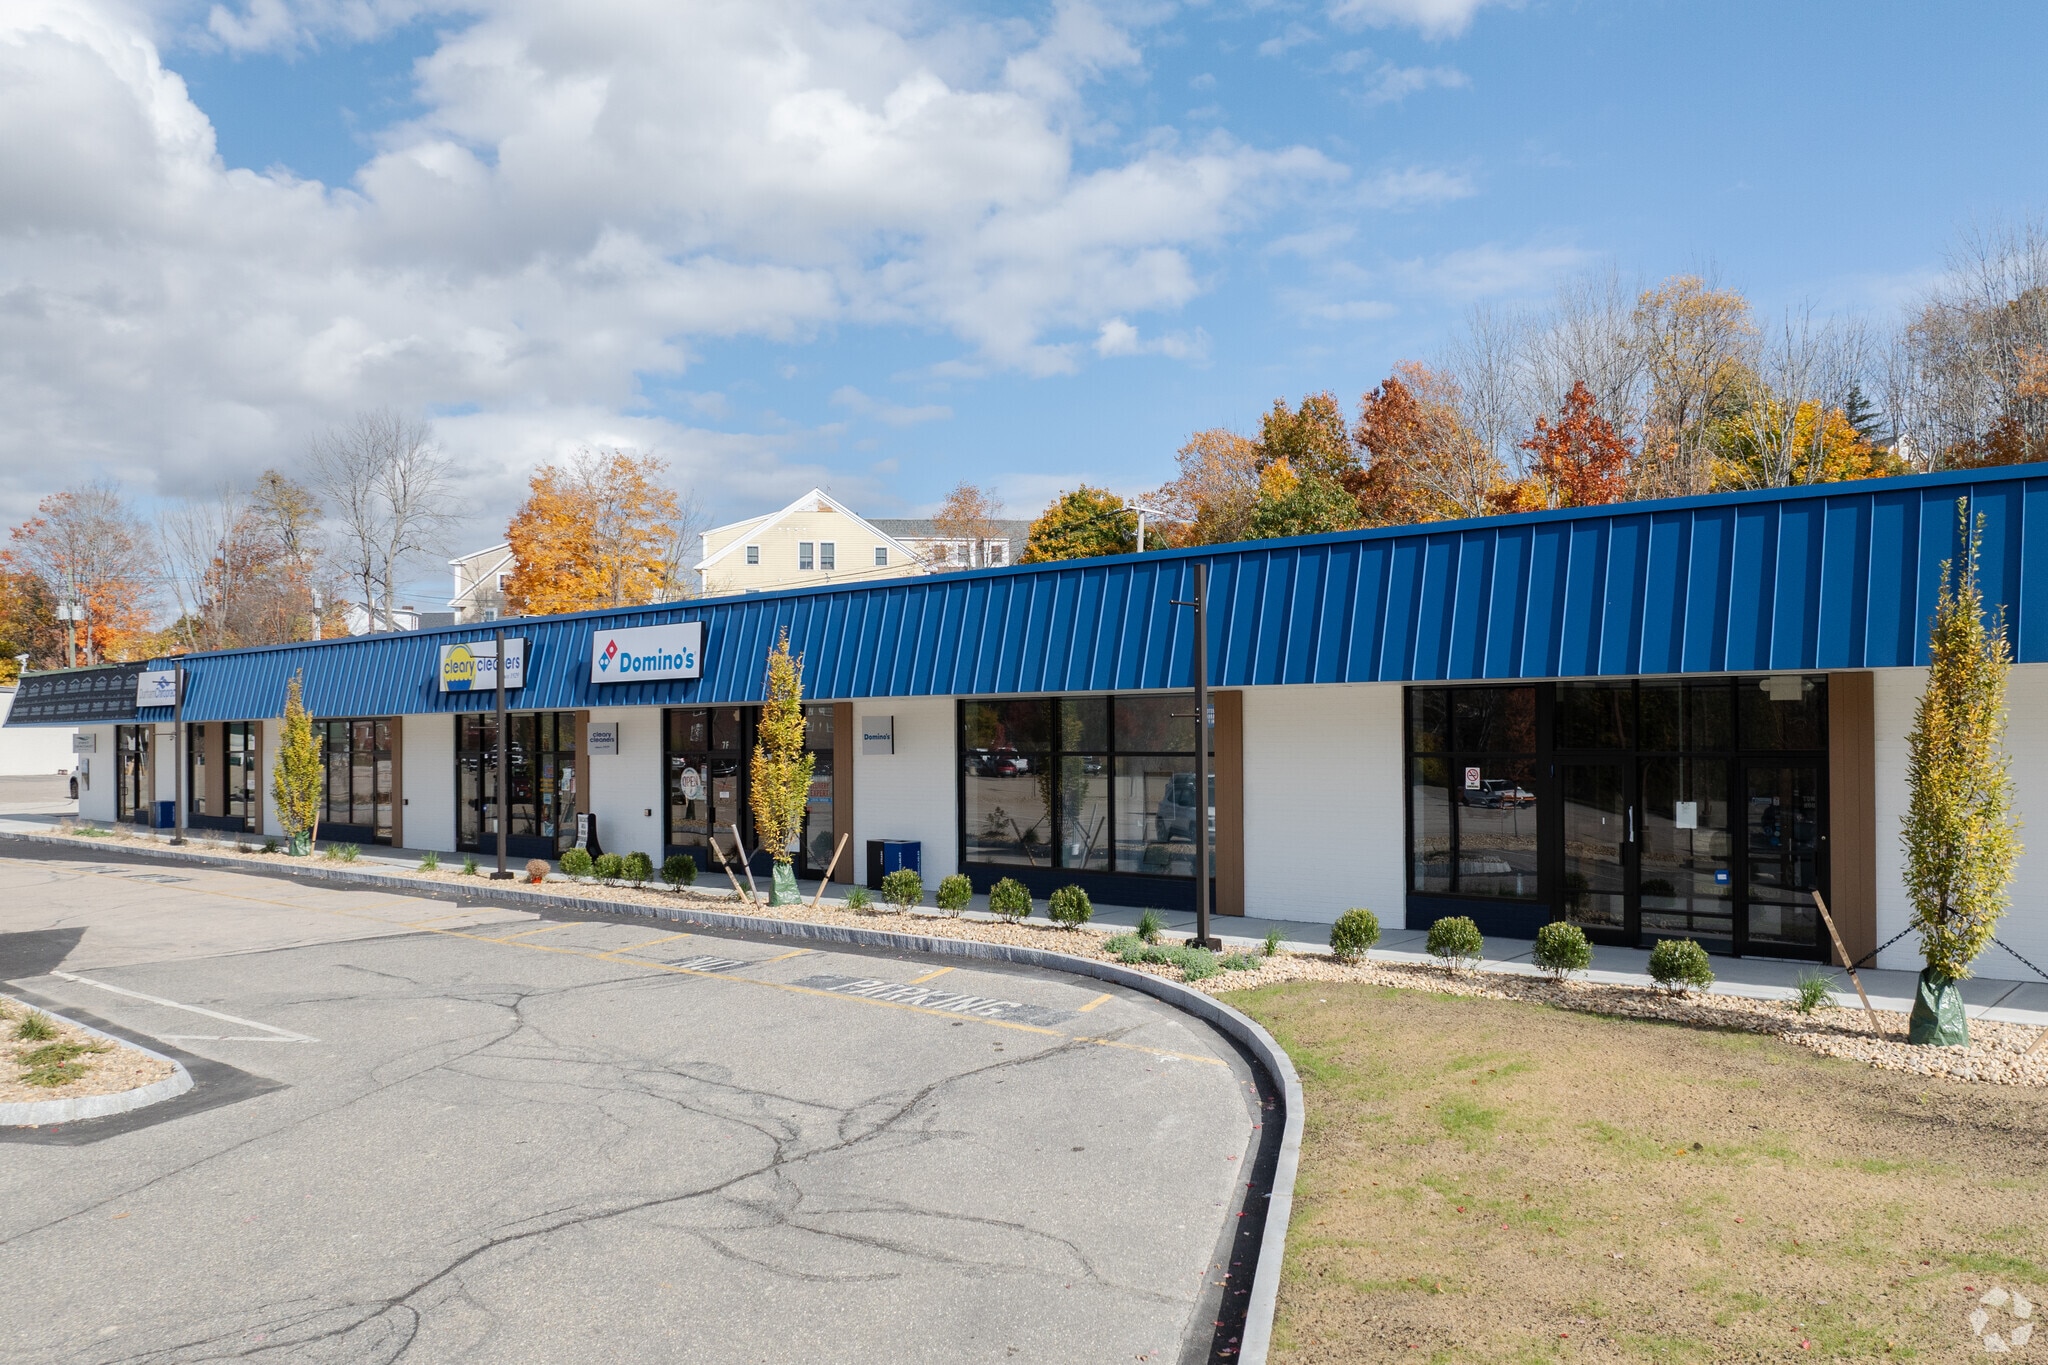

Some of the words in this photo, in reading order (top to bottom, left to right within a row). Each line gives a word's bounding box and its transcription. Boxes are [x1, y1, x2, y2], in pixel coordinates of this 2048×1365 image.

[444, 659, 475, 676] cleary
[620, 646, 694, 672] Domino's
[683, 776, 698, 787] OPEN
[827, 979, 1022, 1017] PARKING
